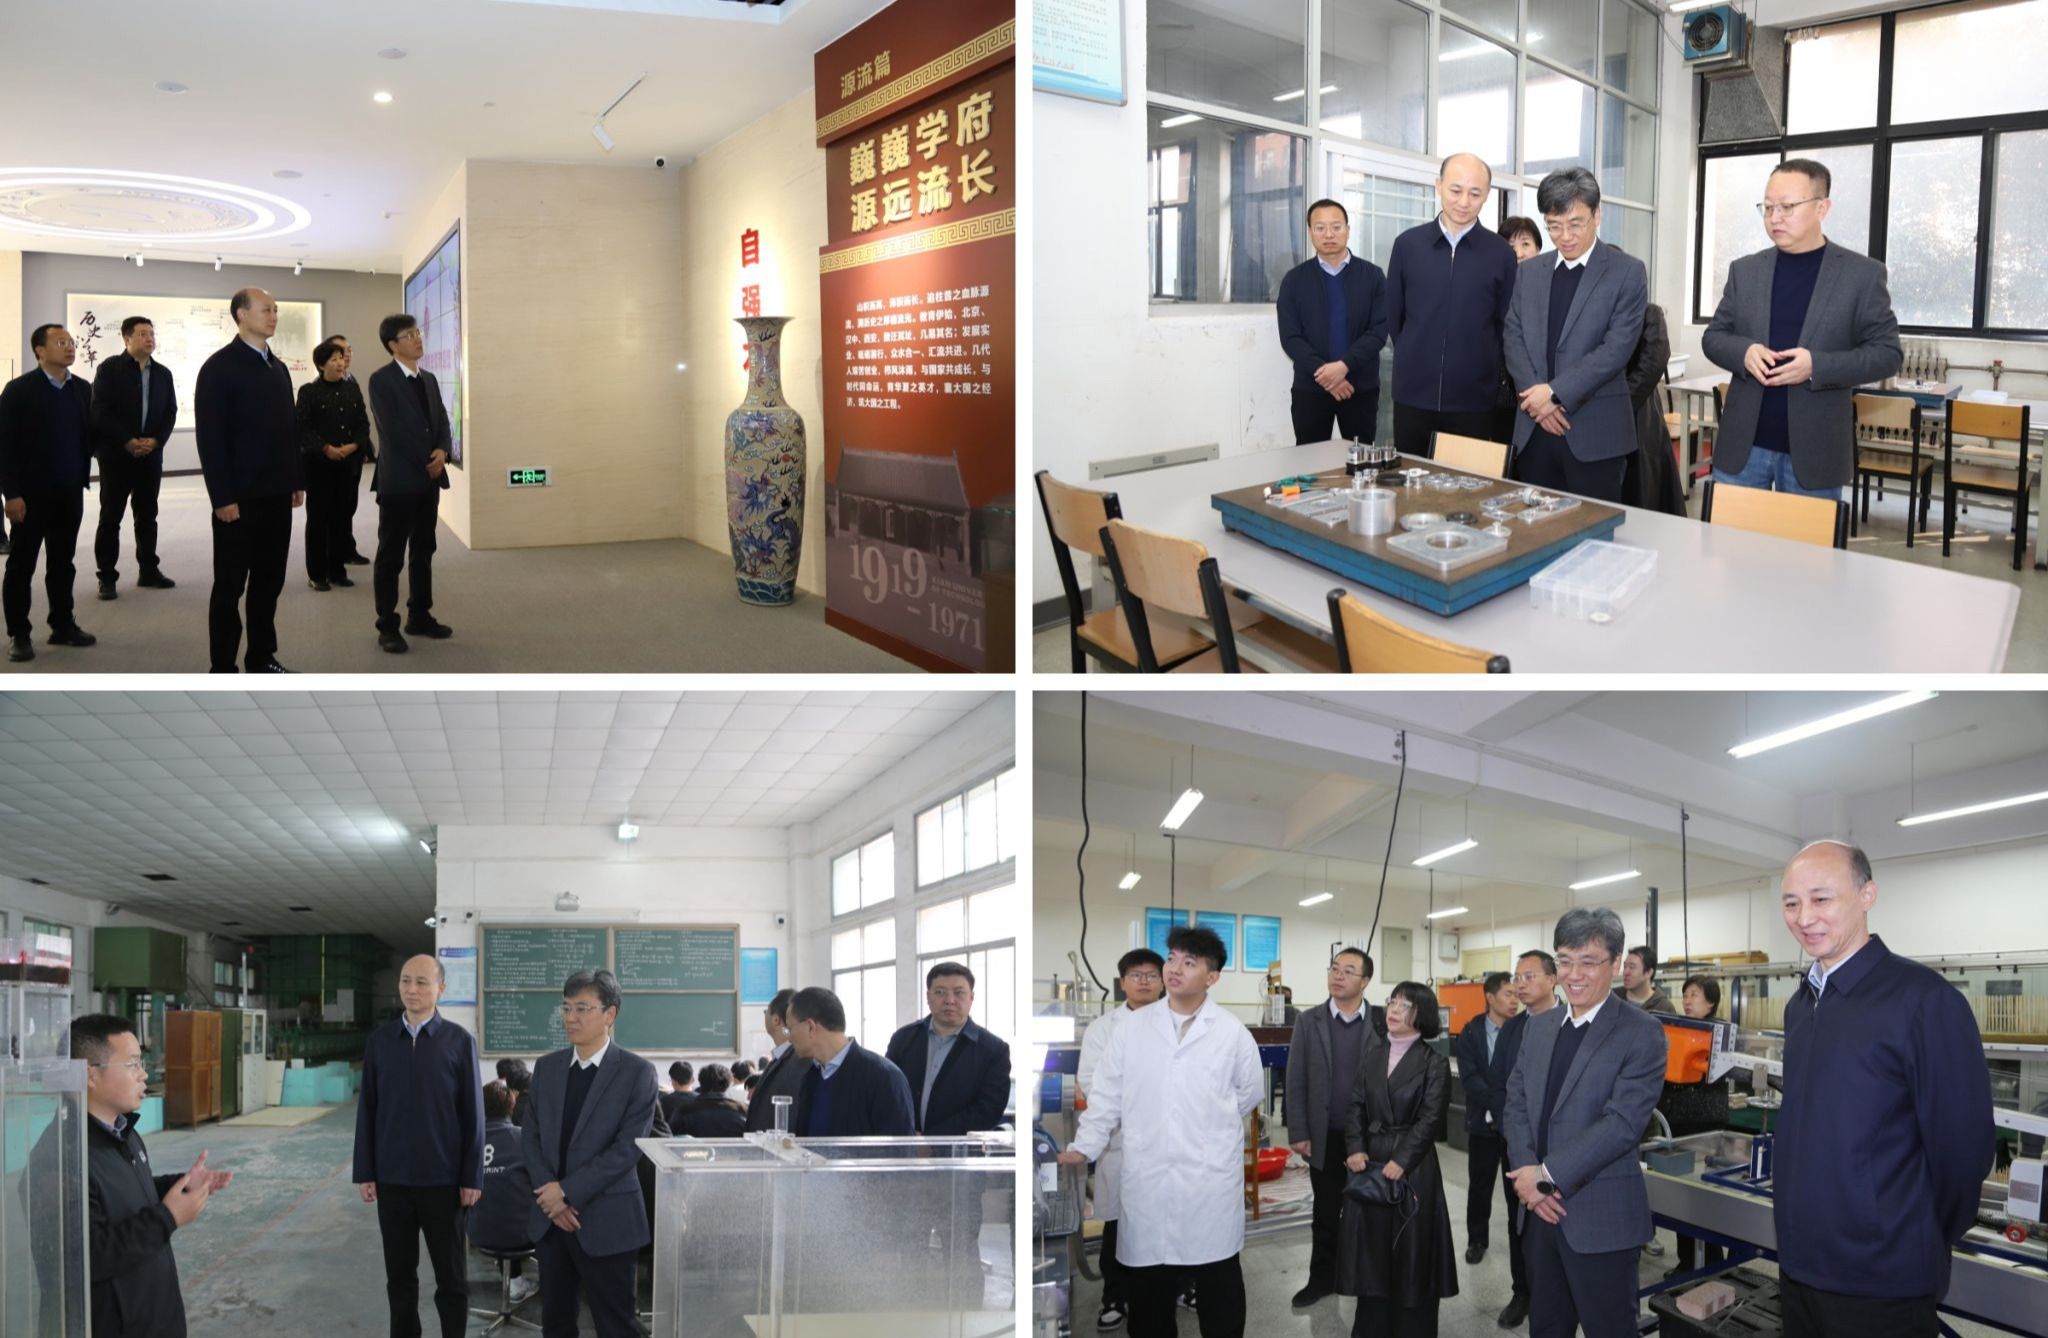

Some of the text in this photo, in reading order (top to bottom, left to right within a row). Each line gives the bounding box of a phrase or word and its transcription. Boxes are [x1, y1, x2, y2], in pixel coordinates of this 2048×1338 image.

[840, 50, 891, 99] 源流篇
[850, 91, 994, 186] 巍巍学府
[851, 149, 996, 233] 源远流长
[850, 544, 927, 604] 1919
